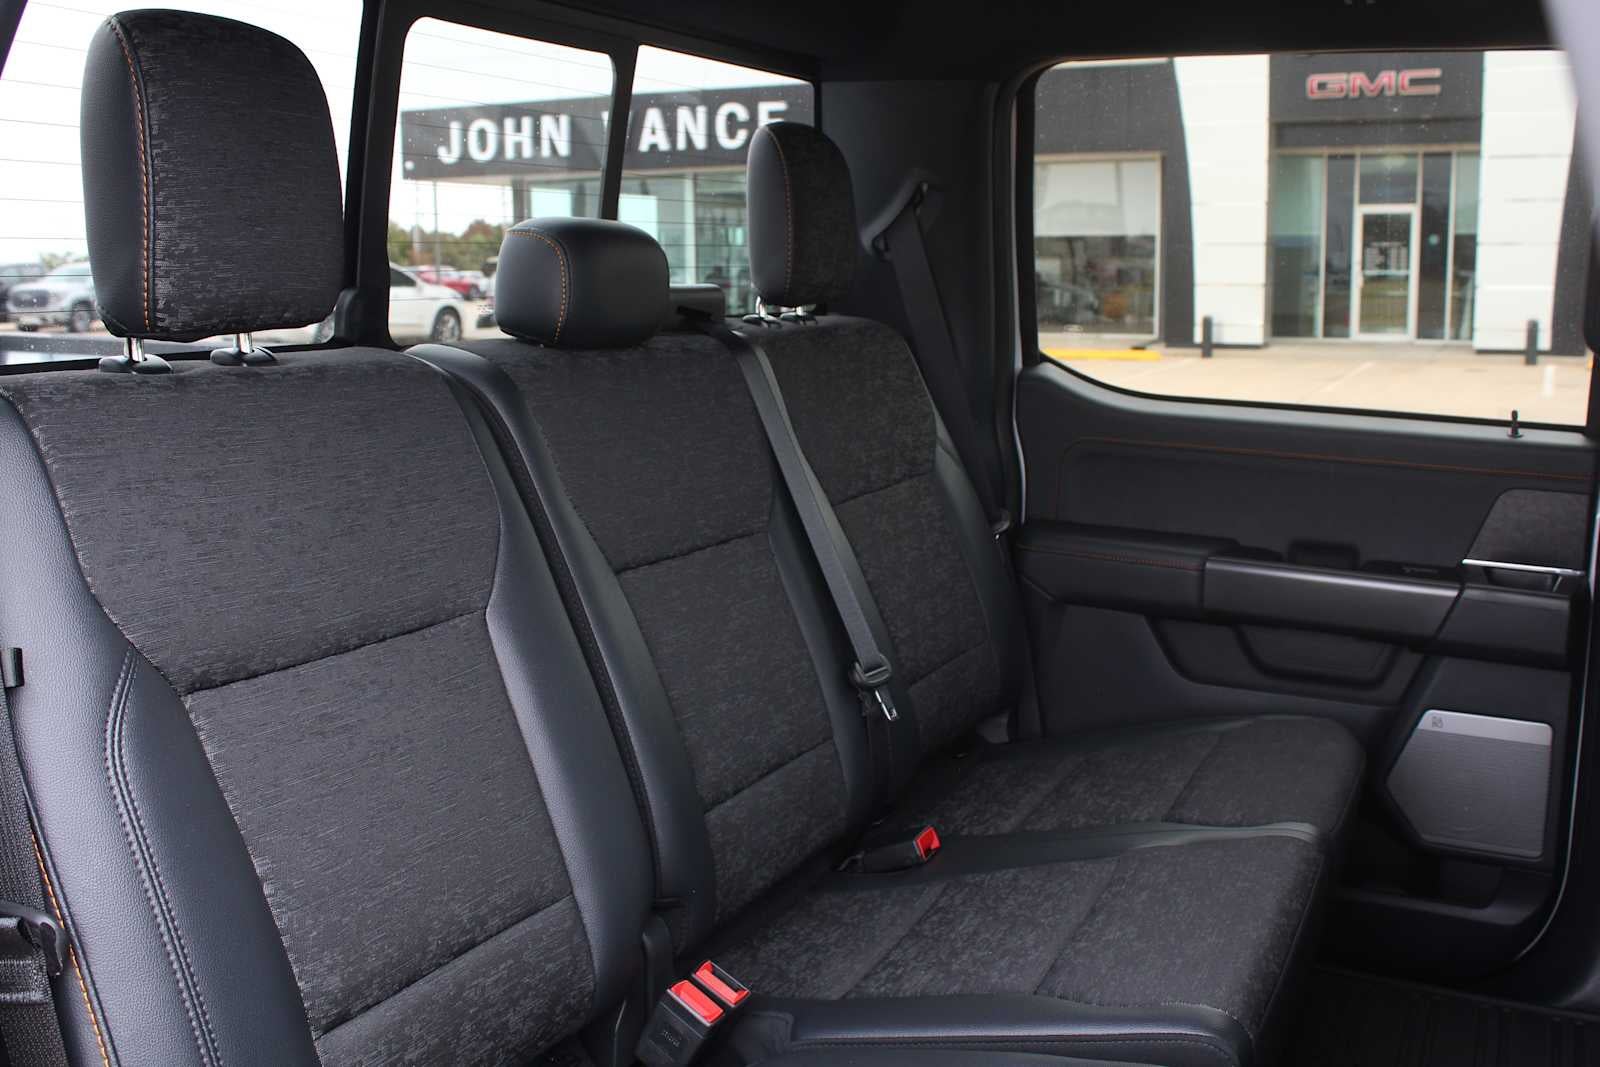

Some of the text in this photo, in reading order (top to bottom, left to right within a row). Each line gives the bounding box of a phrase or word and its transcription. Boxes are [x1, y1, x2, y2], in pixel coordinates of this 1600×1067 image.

[1306, 68, 1442, 99] GMC
[437, 101, 788, 165] JOHN ANCE
